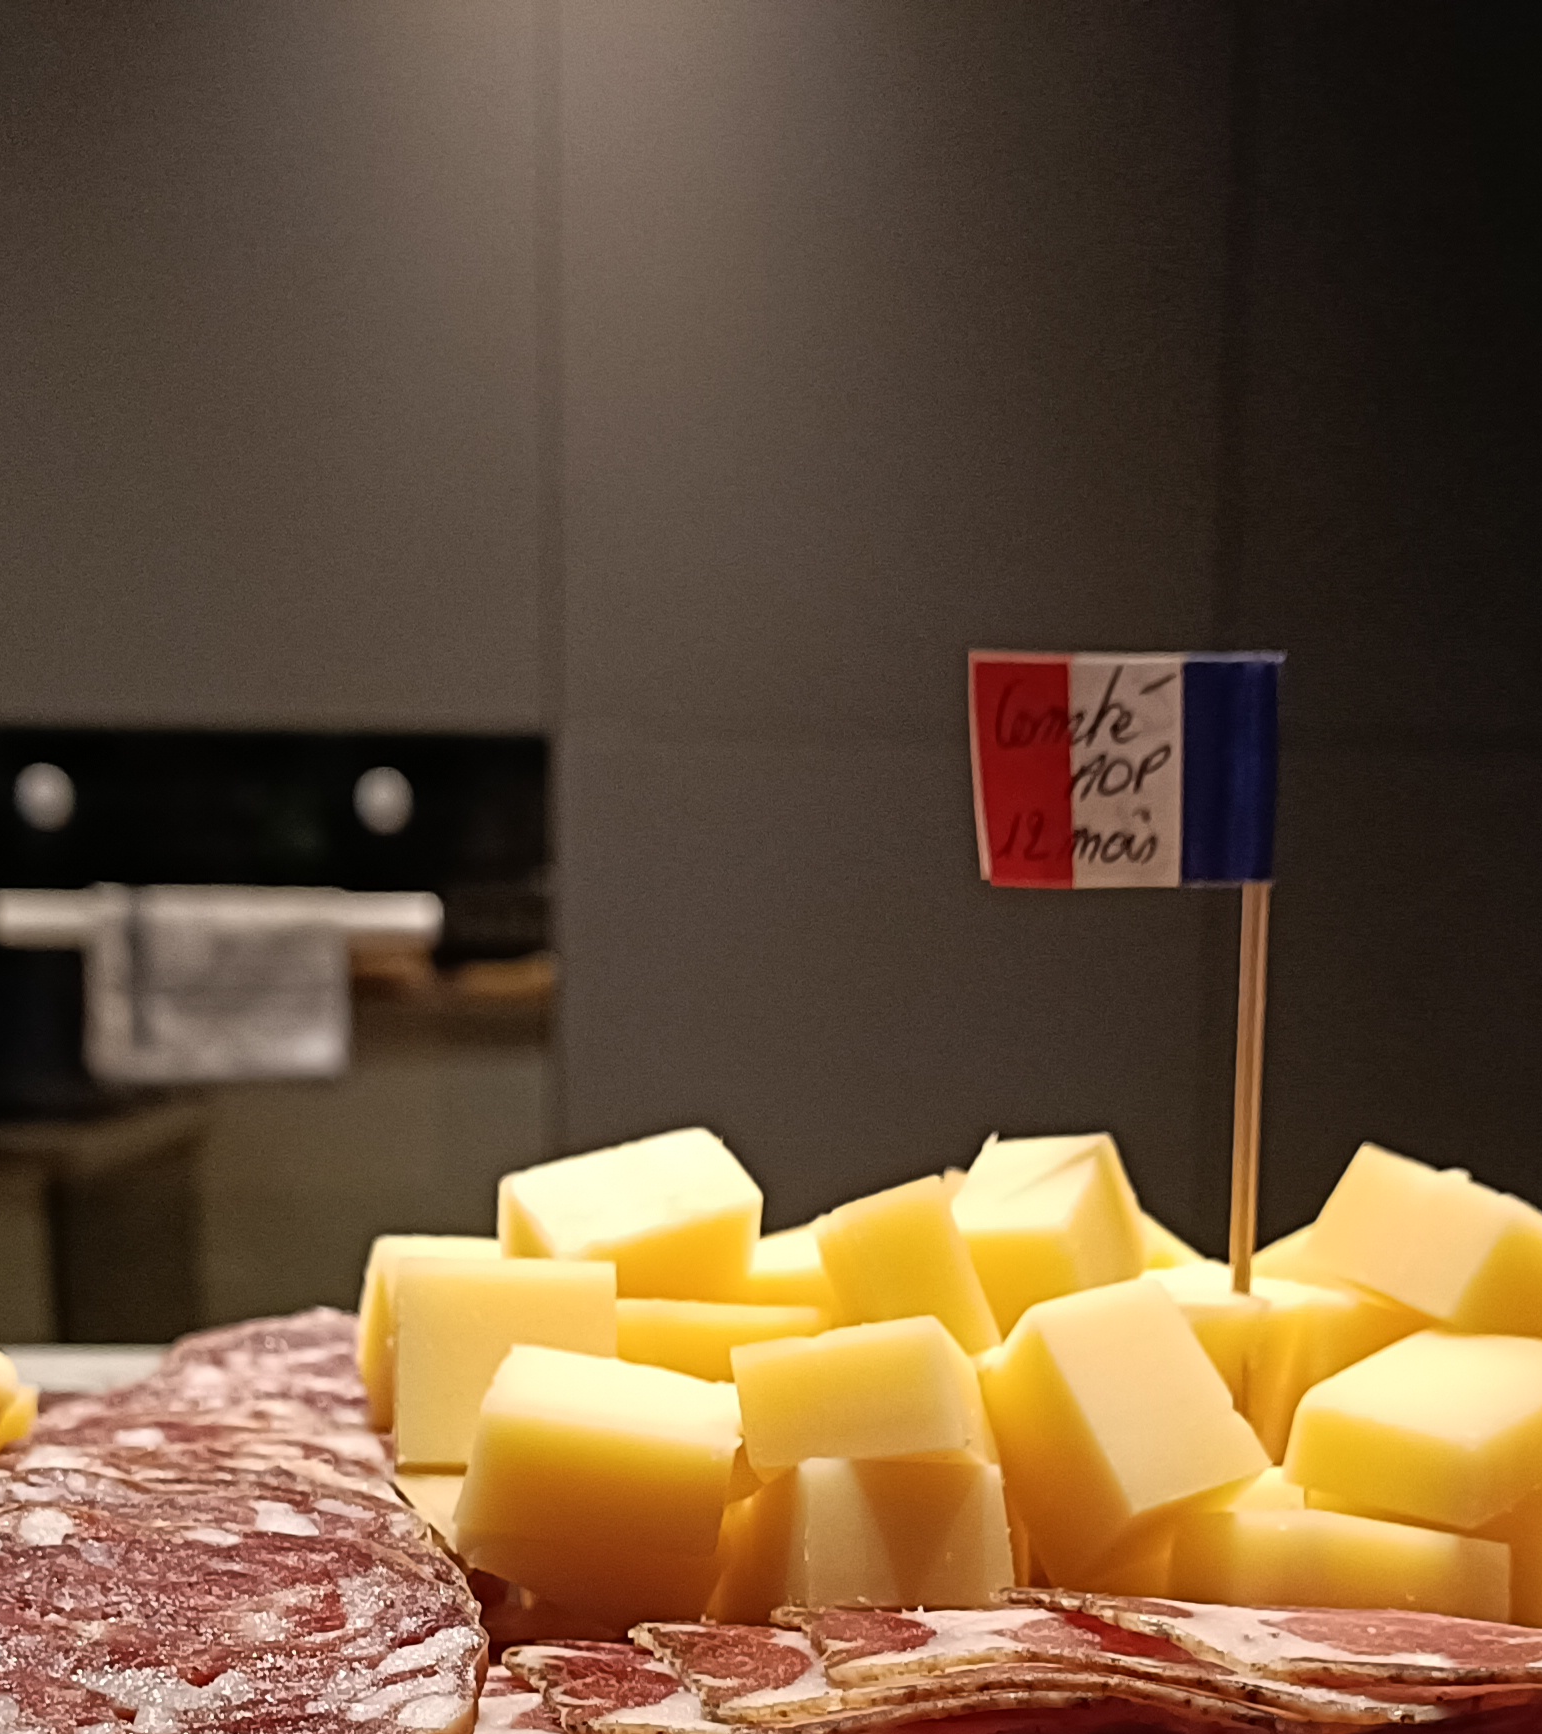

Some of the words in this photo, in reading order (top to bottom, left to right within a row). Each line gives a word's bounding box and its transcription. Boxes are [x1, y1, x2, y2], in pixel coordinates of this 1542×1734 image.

[995, 665, 1177, 749] Comté
[1066, 743, 1172, 801] AOP
[996, 808, 1050, 860] 12
[1061, 807, 1160, 864] mois
